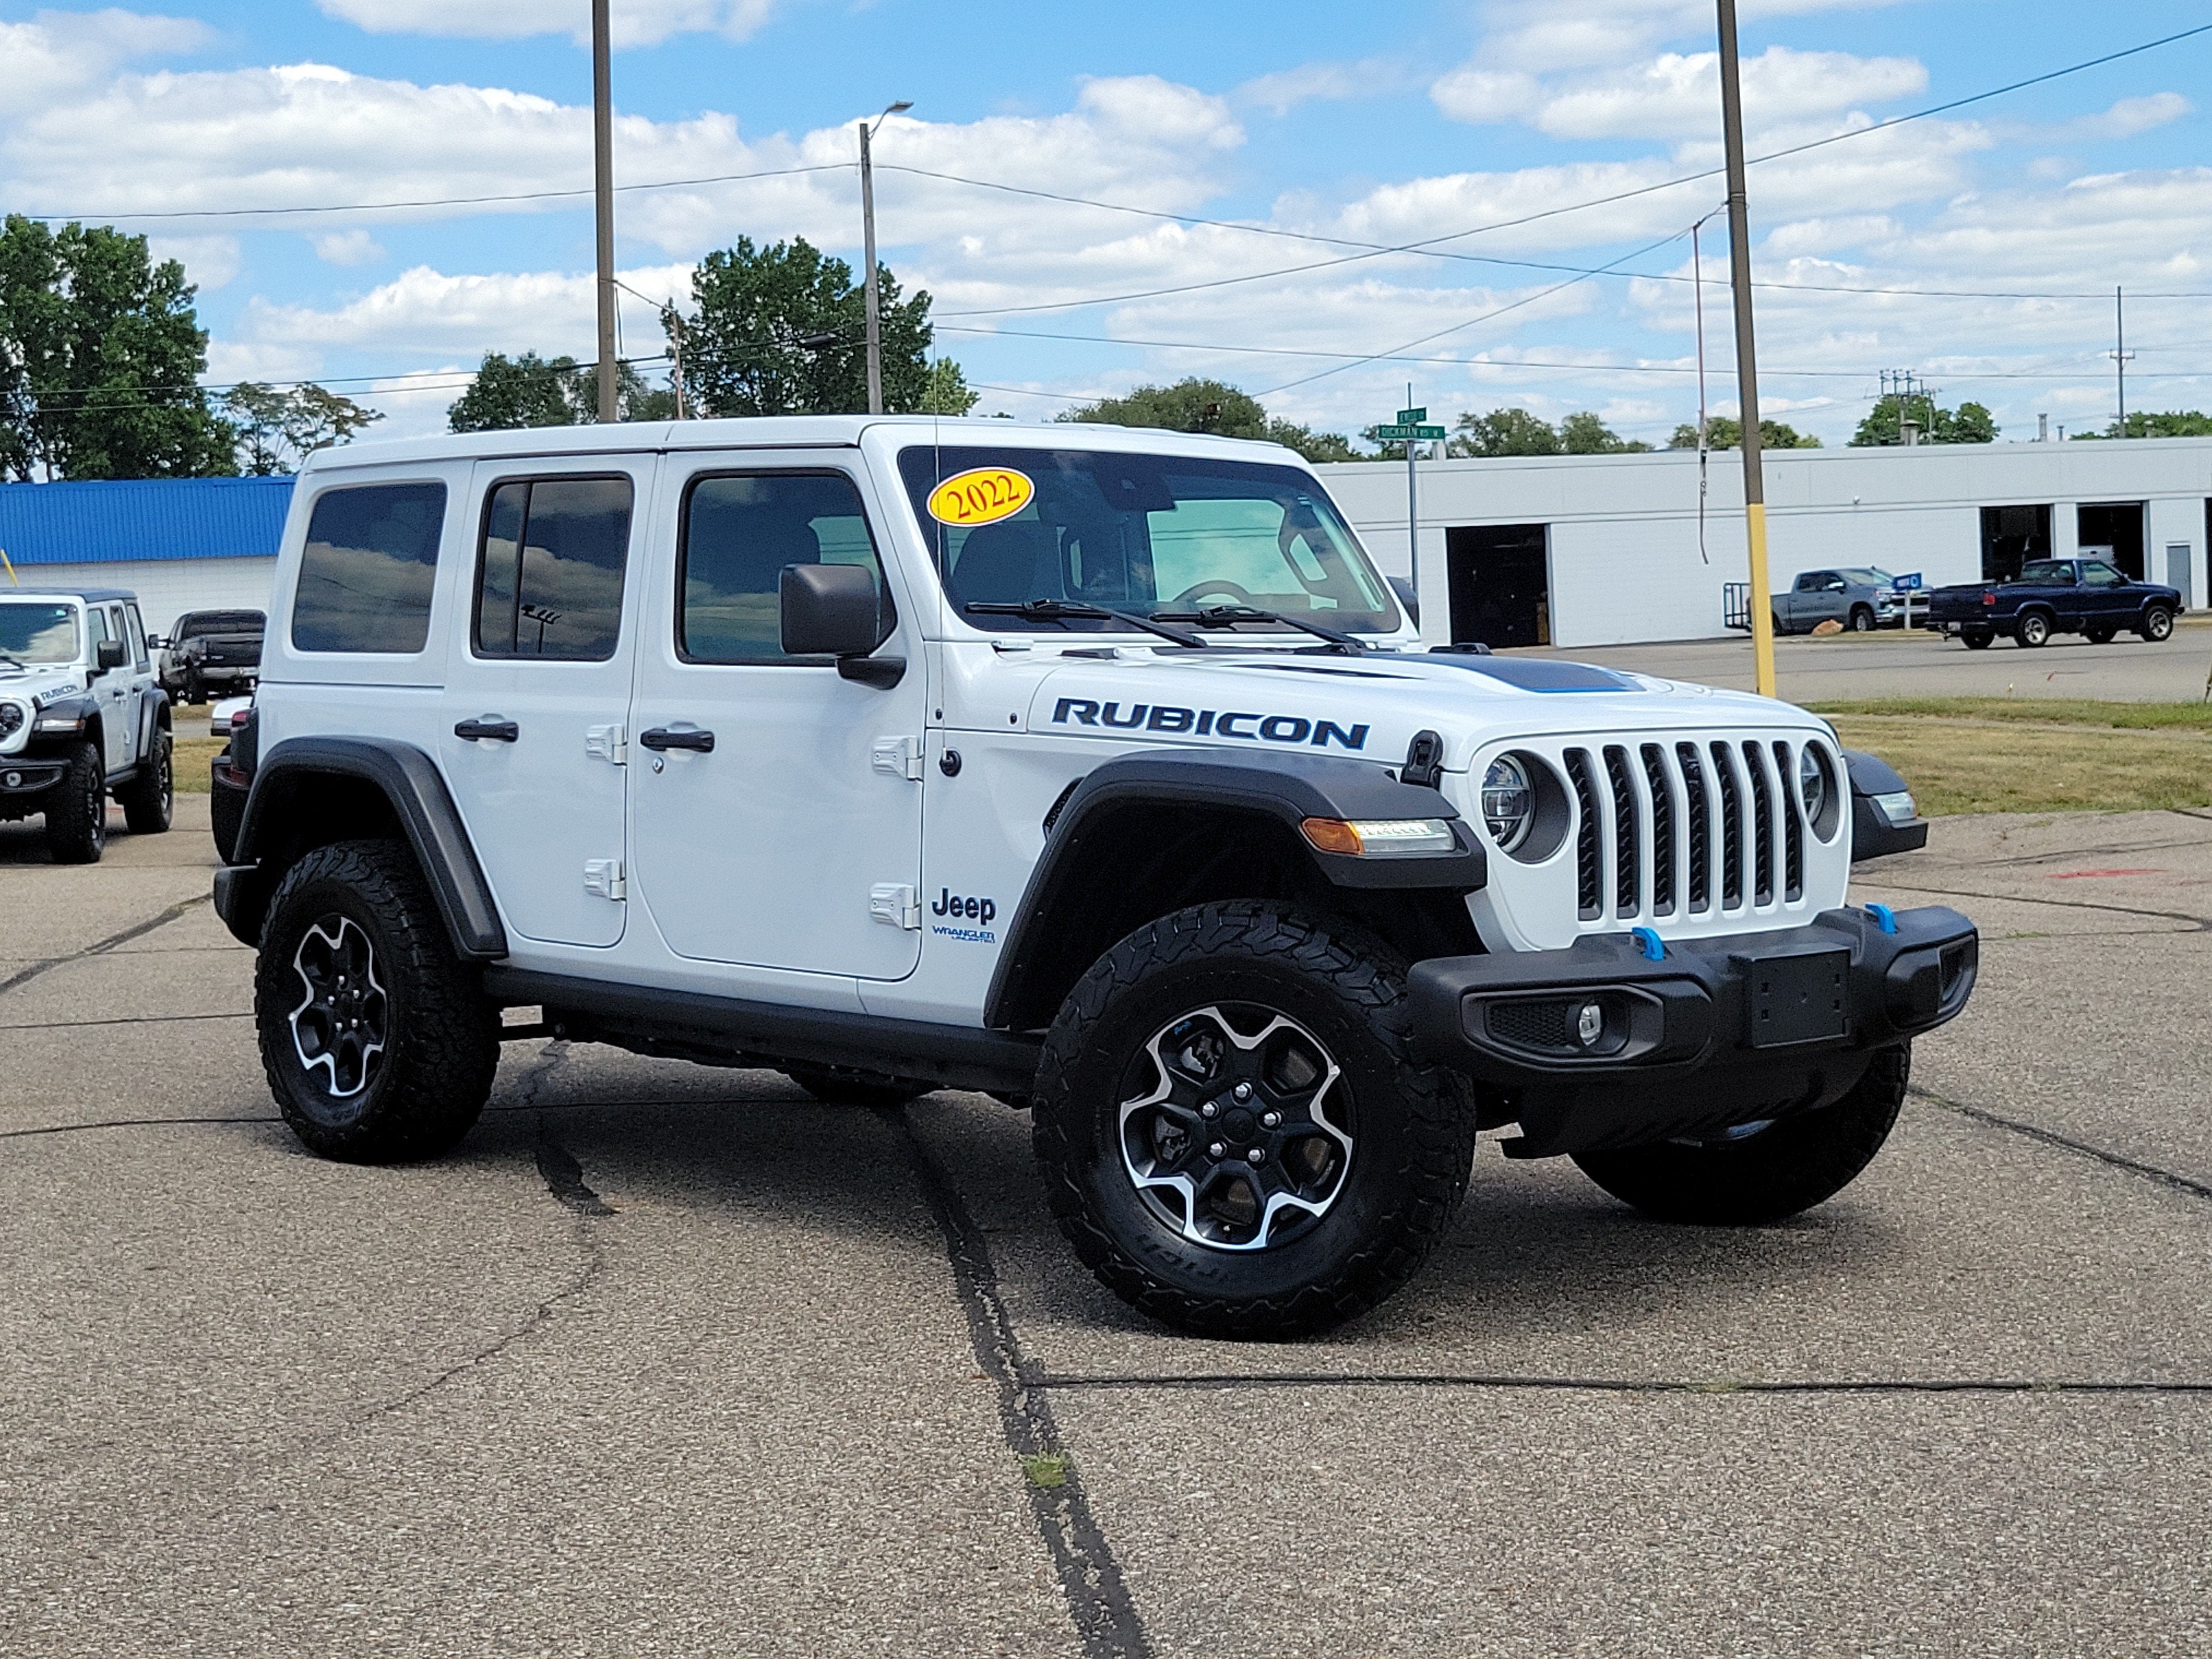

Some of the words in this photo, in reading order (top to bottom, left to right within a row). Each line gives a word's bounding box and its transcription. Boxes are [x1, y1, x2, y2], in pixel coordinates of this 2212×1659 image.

[947, 475, 1020, 520] 2022
[1051, 697, 1370, 751] RUBICON
[932, 888, 996, 926] Jeep
[932, 926, 995, 940] WRANGLER
